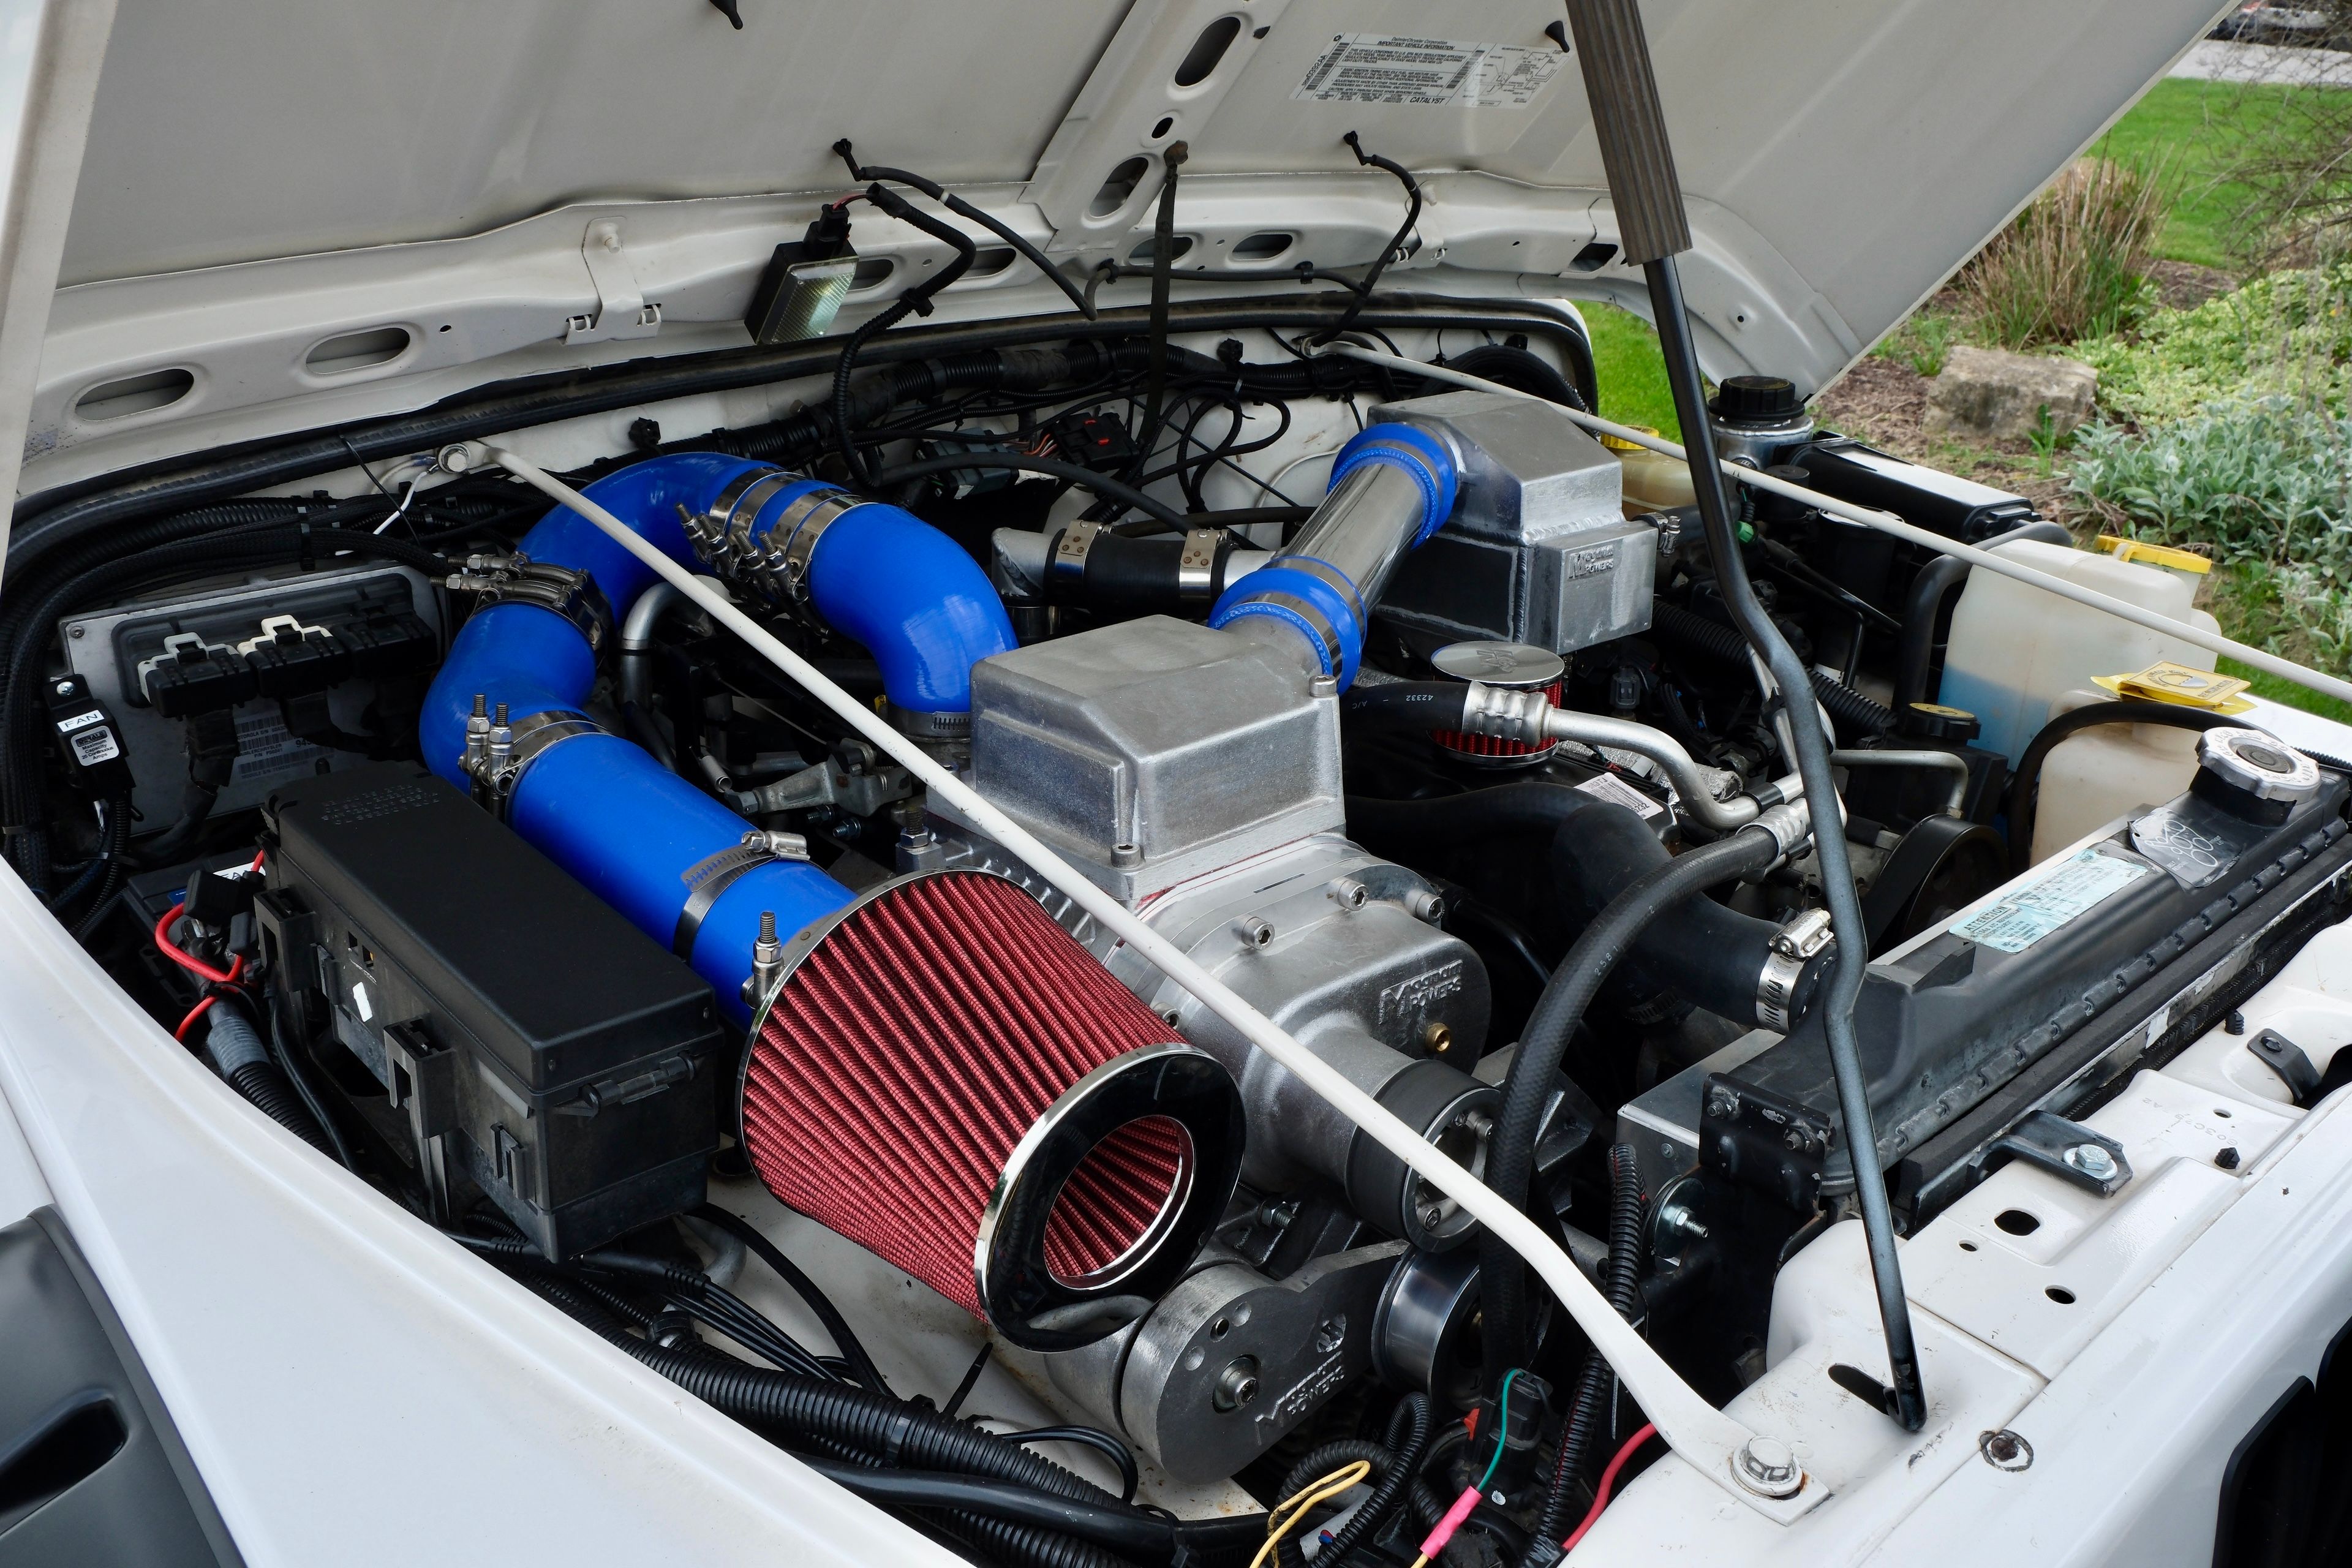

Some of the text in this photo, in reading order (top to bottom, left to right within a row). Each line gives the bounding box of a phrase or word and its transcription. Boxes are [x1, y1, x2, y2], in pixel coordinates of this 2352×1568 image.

[1585, 558, 1614, 573] POWERS
[1352, 701, 1367, 709] A/C
[65, 714, 98, 728] FAN
[81, 740, 107, 750] Maximum
[85, 744, 107, 754] Capacity
[88, 747, 114, 757] Continuous
[1649, 905, 1654, 914] 2
[1964, 906, 2008, 930] ATTENTION
[1594, 946, 1618, 976] 2581
[1409, 976, 1461, 1011] POWERS
[1287, 1365, 1344, 1421] POWERS
